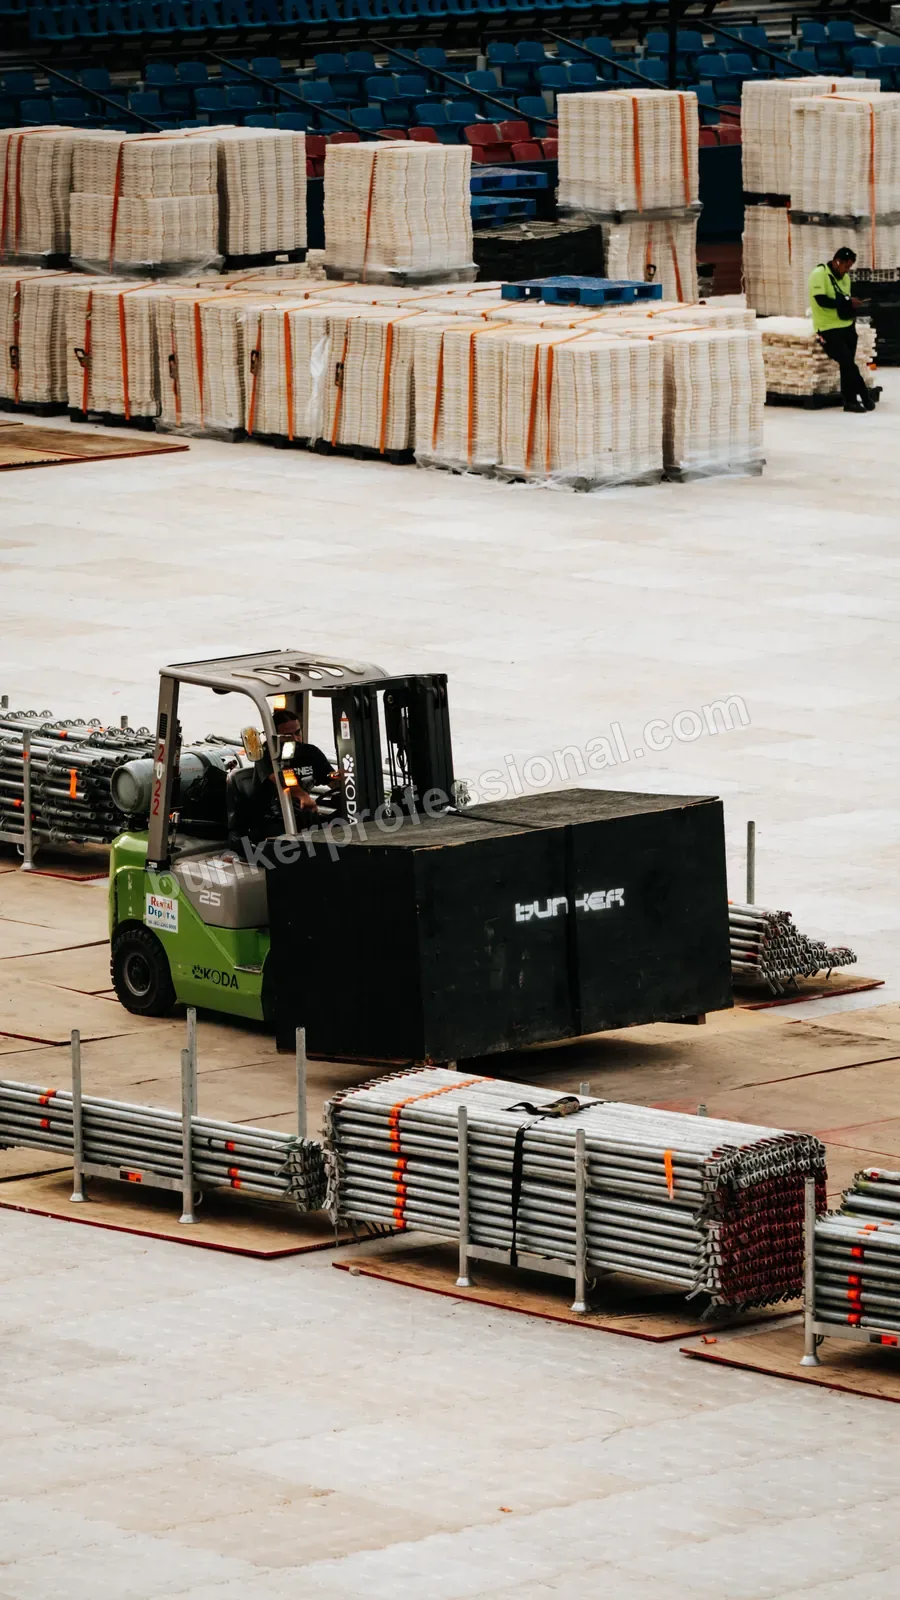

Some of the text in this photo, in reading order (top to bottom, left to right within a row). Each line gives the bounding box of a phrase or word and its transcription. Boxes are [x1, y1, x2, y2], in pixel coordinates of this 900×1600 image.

[152, 744, 165, 816] 2022
[344, 772, 358, 826] KODA
[199, 889, 222, 907] 25
[203, 967, 239, 990] KODA
